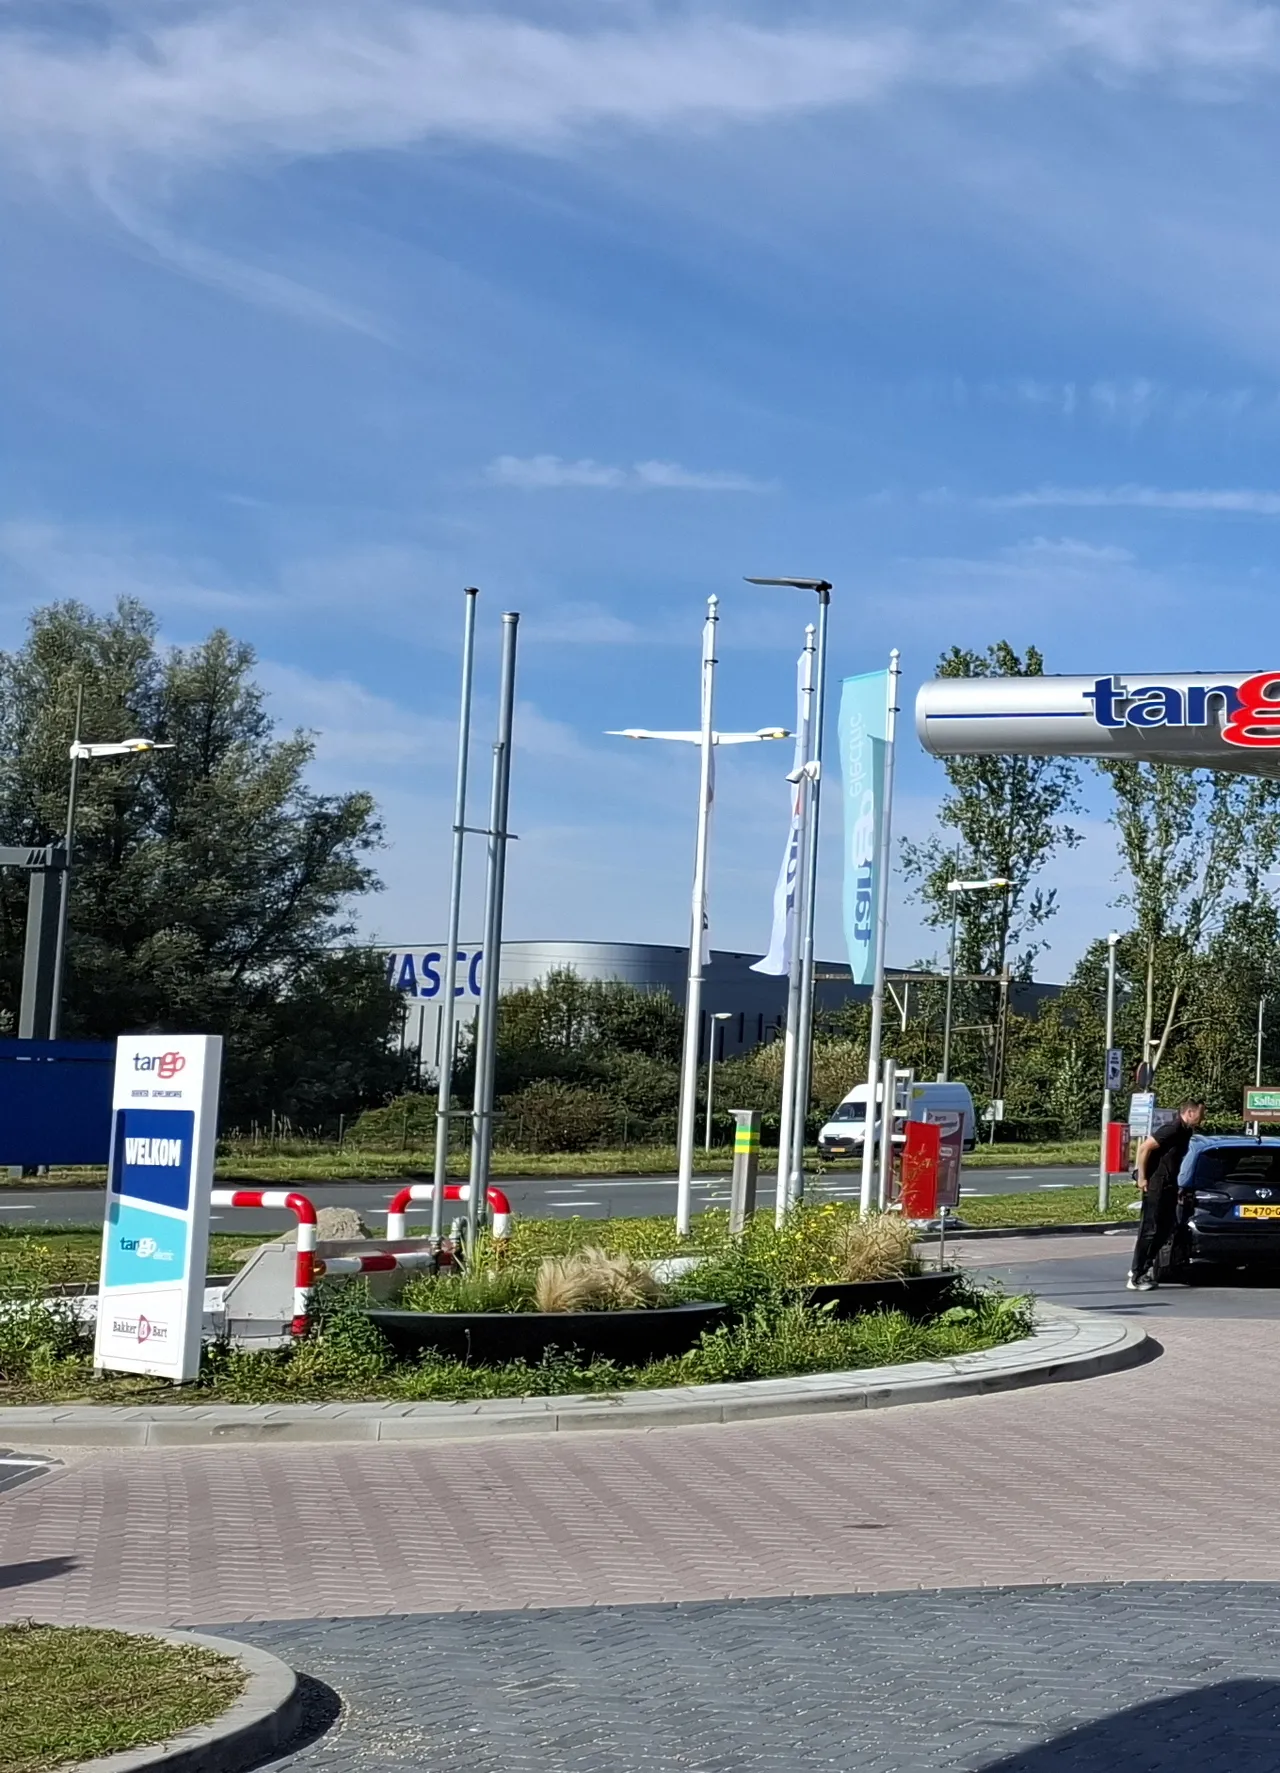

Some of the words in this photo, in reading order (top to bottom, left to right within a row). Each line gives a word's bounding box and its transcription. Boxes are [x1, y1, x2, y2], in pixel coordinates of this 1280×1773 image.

[132, 1051, 186, 1080] tango
[125, 1137, 181, 1168] WELKOM
[120, 1237, 157, 1258] tango
